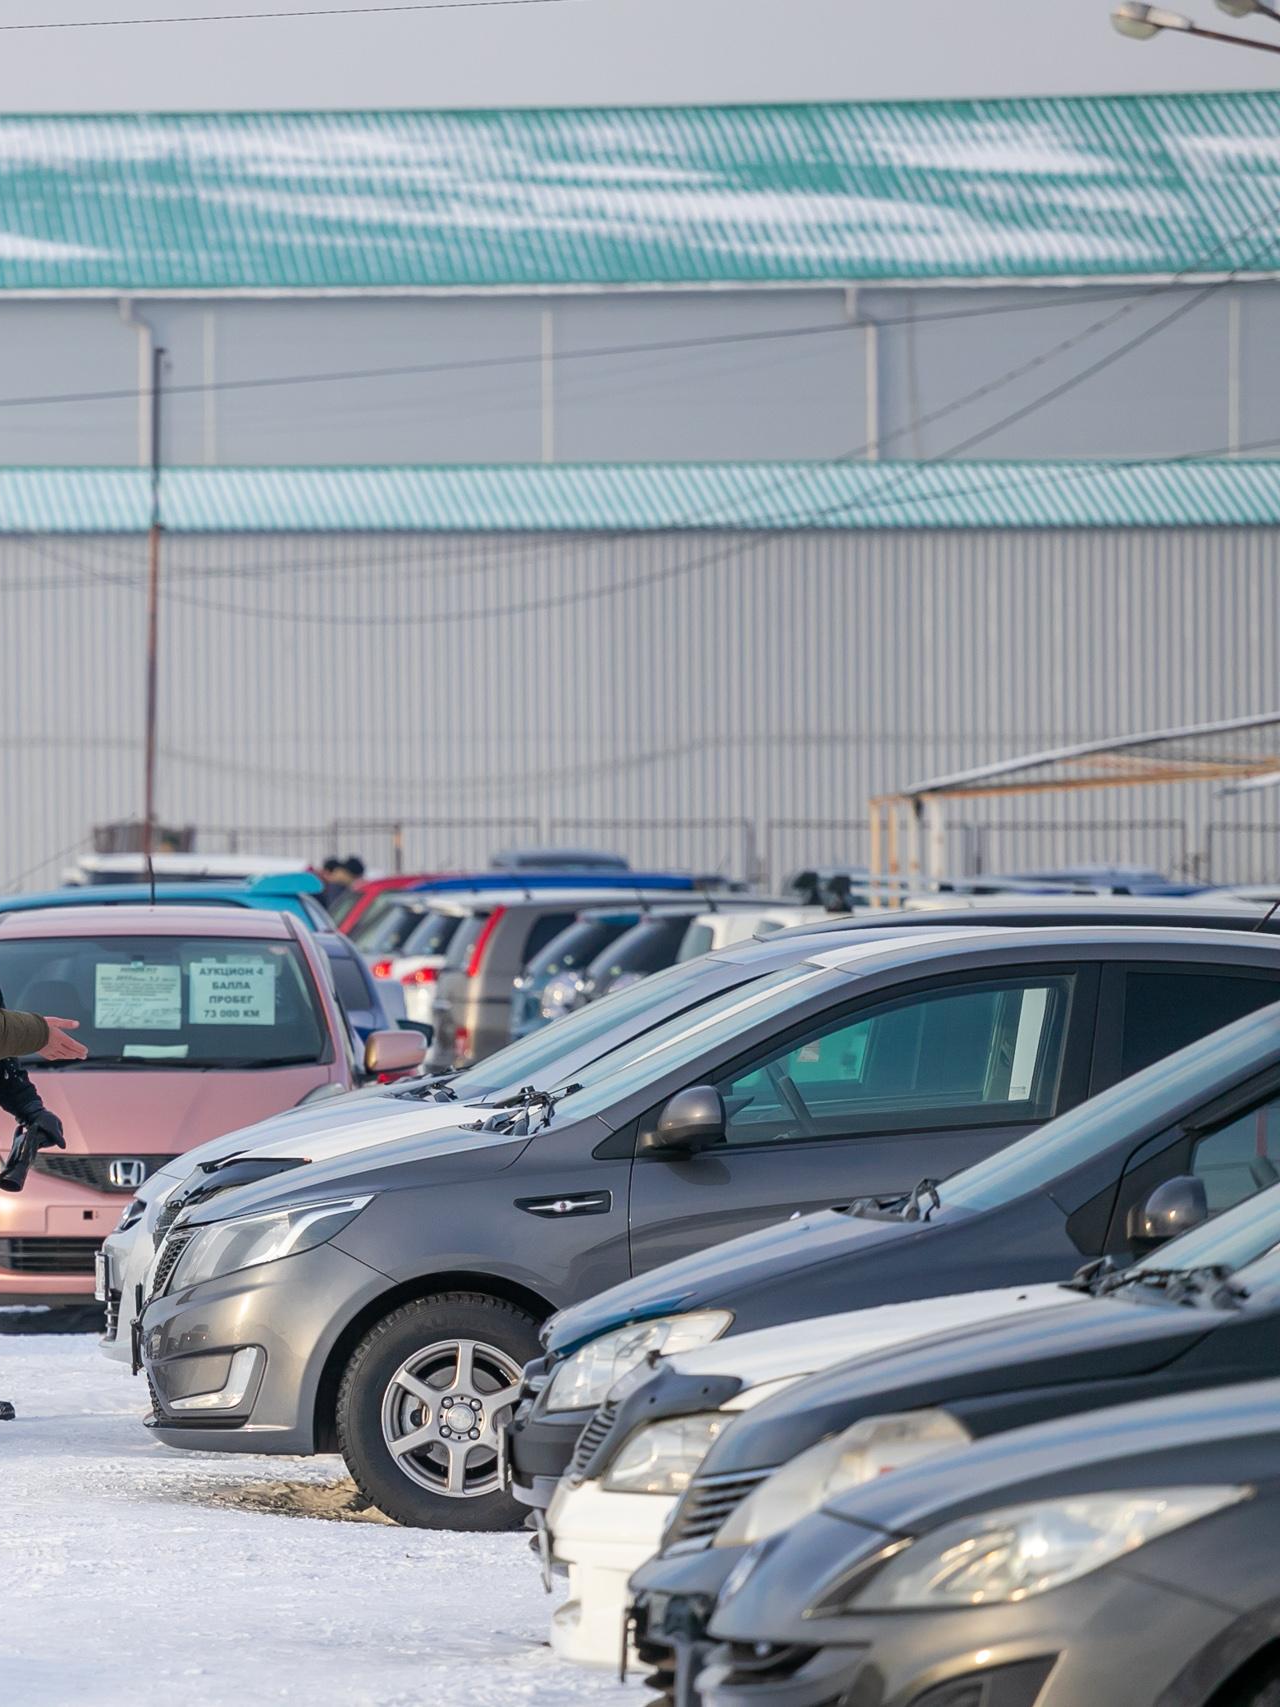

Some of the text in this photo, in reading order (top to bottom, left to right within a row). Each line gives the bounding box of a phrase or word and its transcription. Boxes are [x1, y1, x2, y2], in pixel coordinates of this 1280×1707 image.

[199, 967, 264, 977] АУКЦИОН 4
[212, 981, 251, 990] БАЛЛА
[209, 995, 254, 1004] ПРОБЕГ
[203, 1010, 260, 1018] 73 000 КМ
